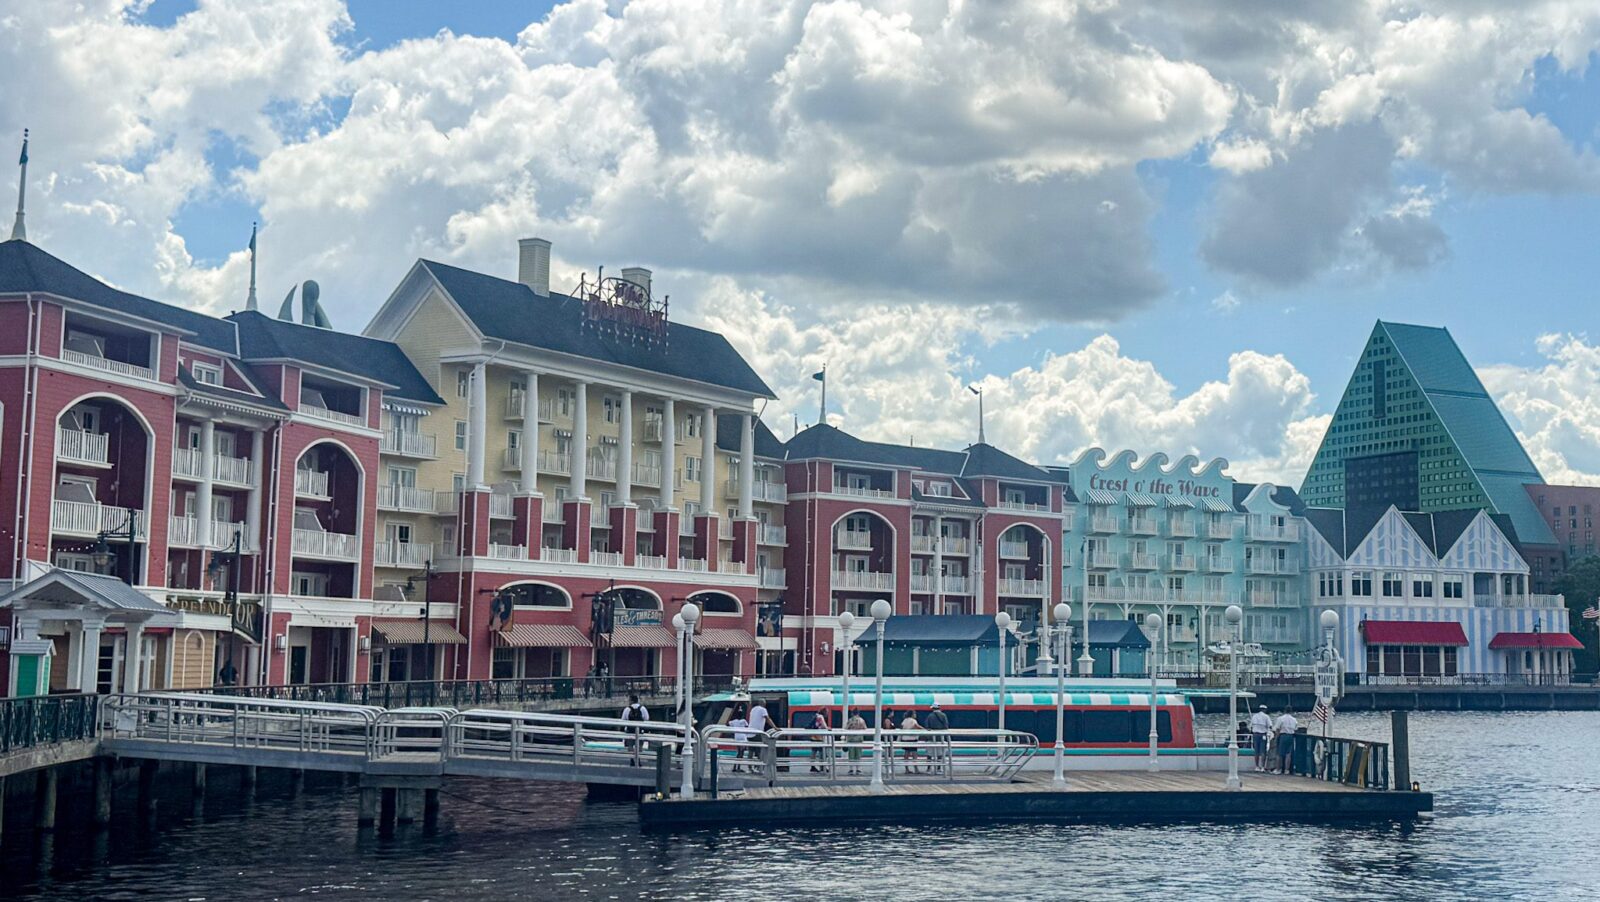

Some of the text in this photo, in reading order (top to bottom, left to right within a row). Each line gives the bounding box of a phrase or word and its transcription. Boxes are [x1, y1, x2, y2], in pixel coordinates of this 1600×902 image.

[1090, 473, 1128, 491] Crest
[1149, 478, 1173, 494] the
[1178, 480, 1219, 497] Wave
[166, 600, 216, 615] CREEN
